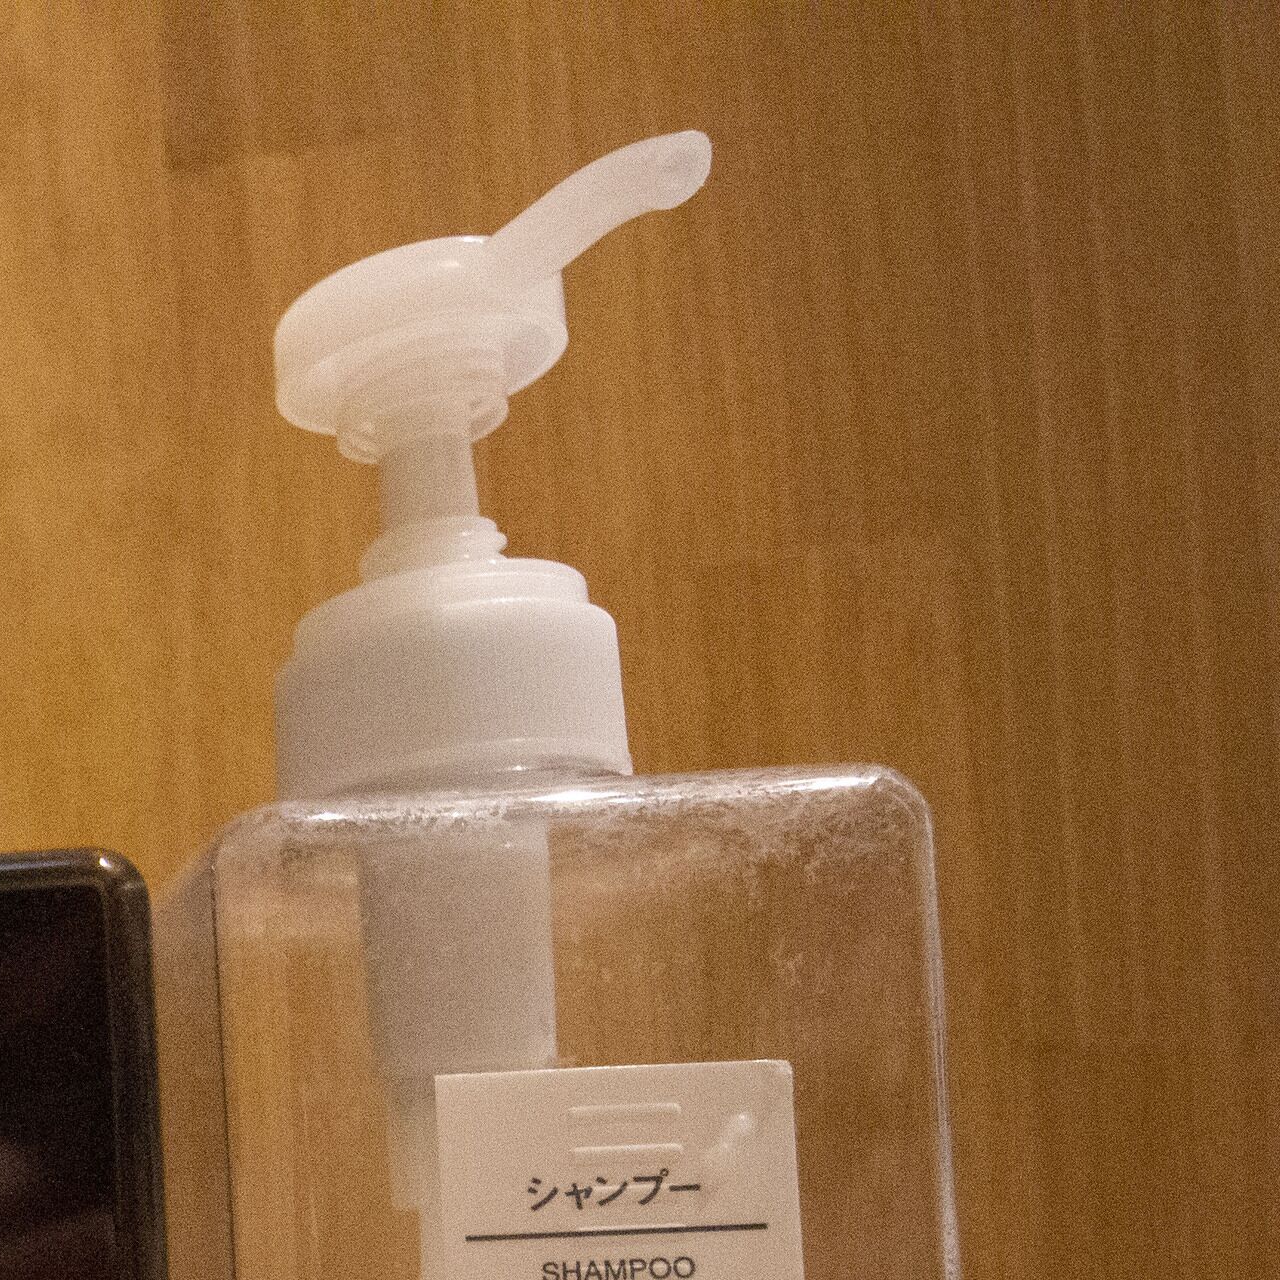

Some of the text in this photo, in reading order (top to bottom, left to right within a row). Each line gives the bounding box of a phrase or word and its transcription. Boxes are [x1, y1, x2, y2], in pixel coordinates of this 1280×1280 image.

[527, 1168, 701, 1211] シャンプー
